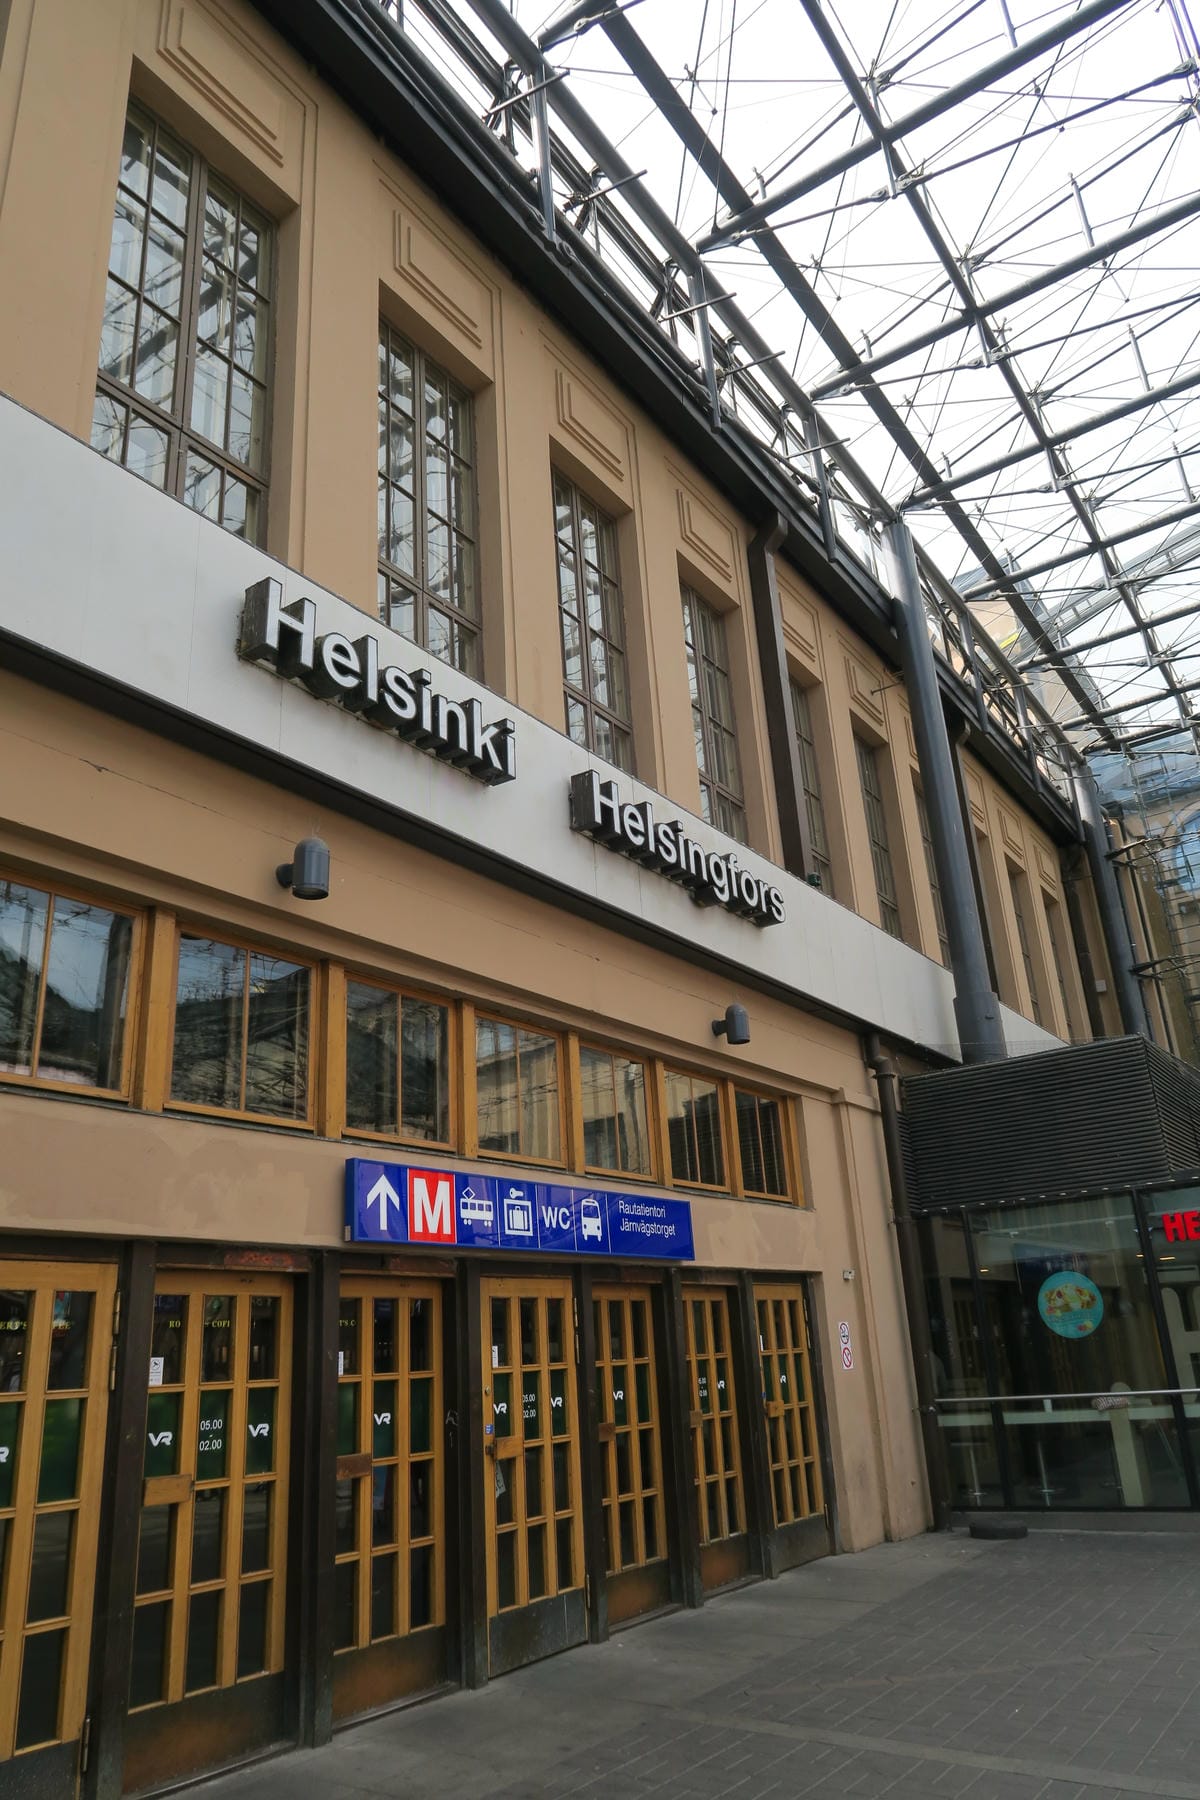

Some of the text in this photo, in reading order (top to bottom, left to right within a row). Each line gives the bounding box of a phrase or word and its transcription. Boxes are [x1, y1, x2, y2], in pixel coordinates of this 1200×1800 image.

[254, 577, 516, 782] Helsinki
[584, 769, 787, 924] Helsingfors
[413, 1177, 452, 1235] M
[541, 1204, 571, 1230] WC
[618, 1200, 666, 1218] Rautatientori
[619, 1220, 676, 1238] Järnvägstorget
[200, 1419, 223, 1431] 05.00
[199, 1439, 222, 1451] 02.00
